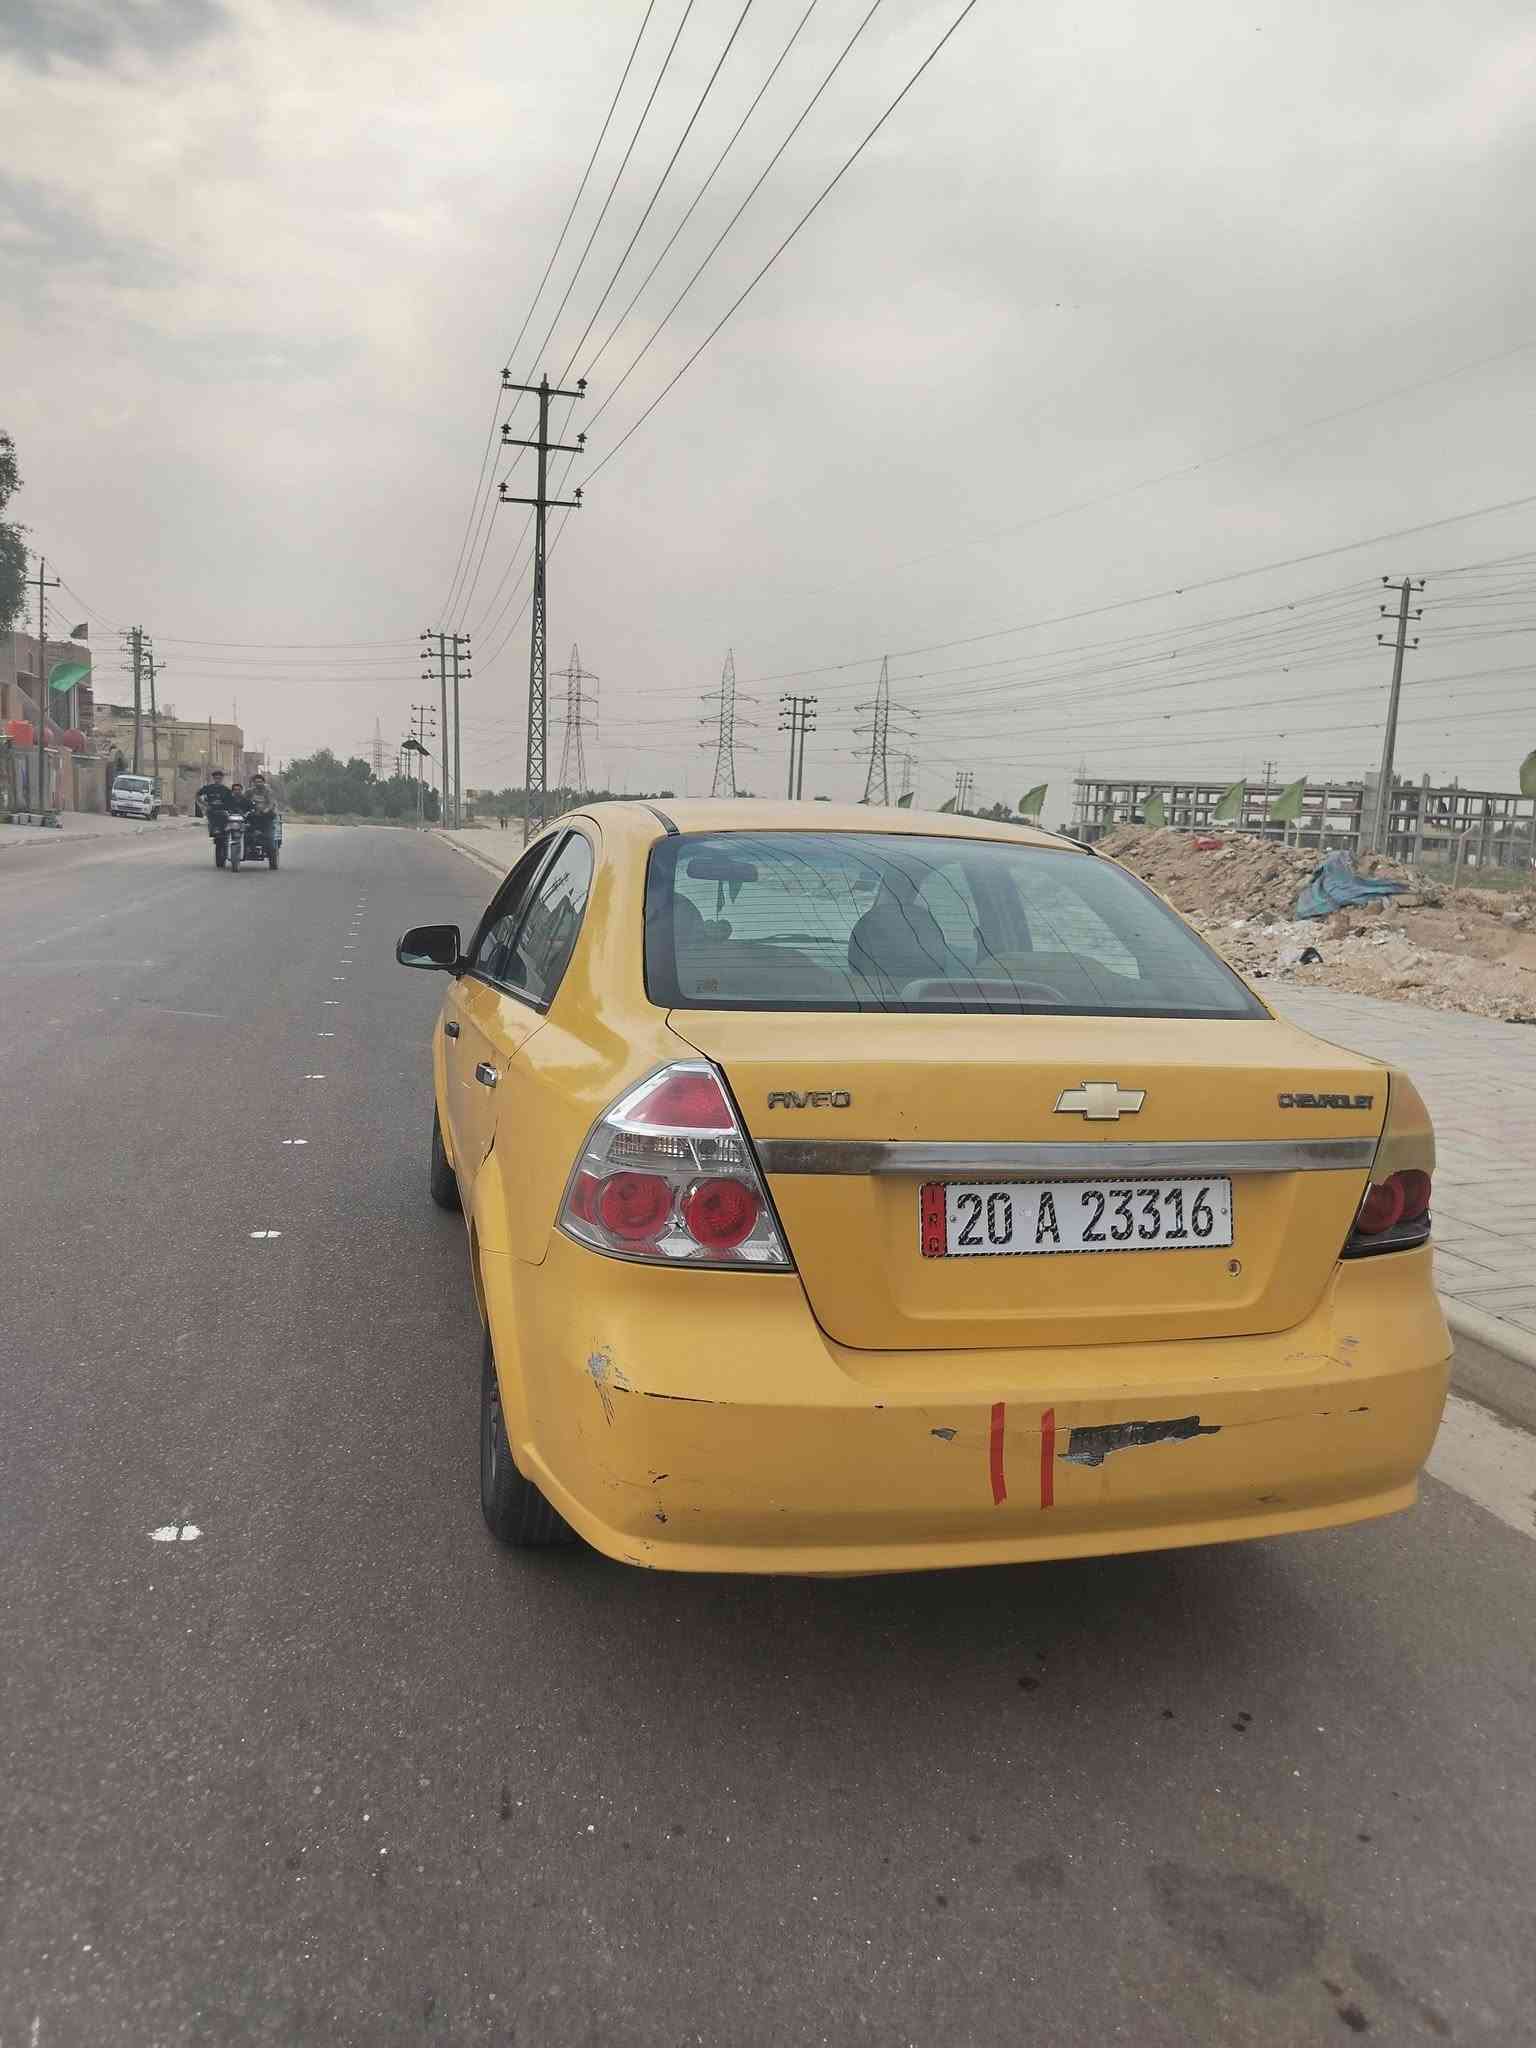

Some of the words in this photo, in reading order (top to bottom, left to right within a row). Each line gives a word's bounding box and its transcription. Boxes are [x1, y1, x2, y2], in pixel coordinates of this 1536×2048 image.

[767, 1091, 851, 1109] AVEO
[1278, 1093, 1374, 1110] CHEVROLET
[957, 1192, 1013, 1246] 20
[1035, 1191, 1061, 1244] A
[1081, 1187, 1214, 1242] 23316
